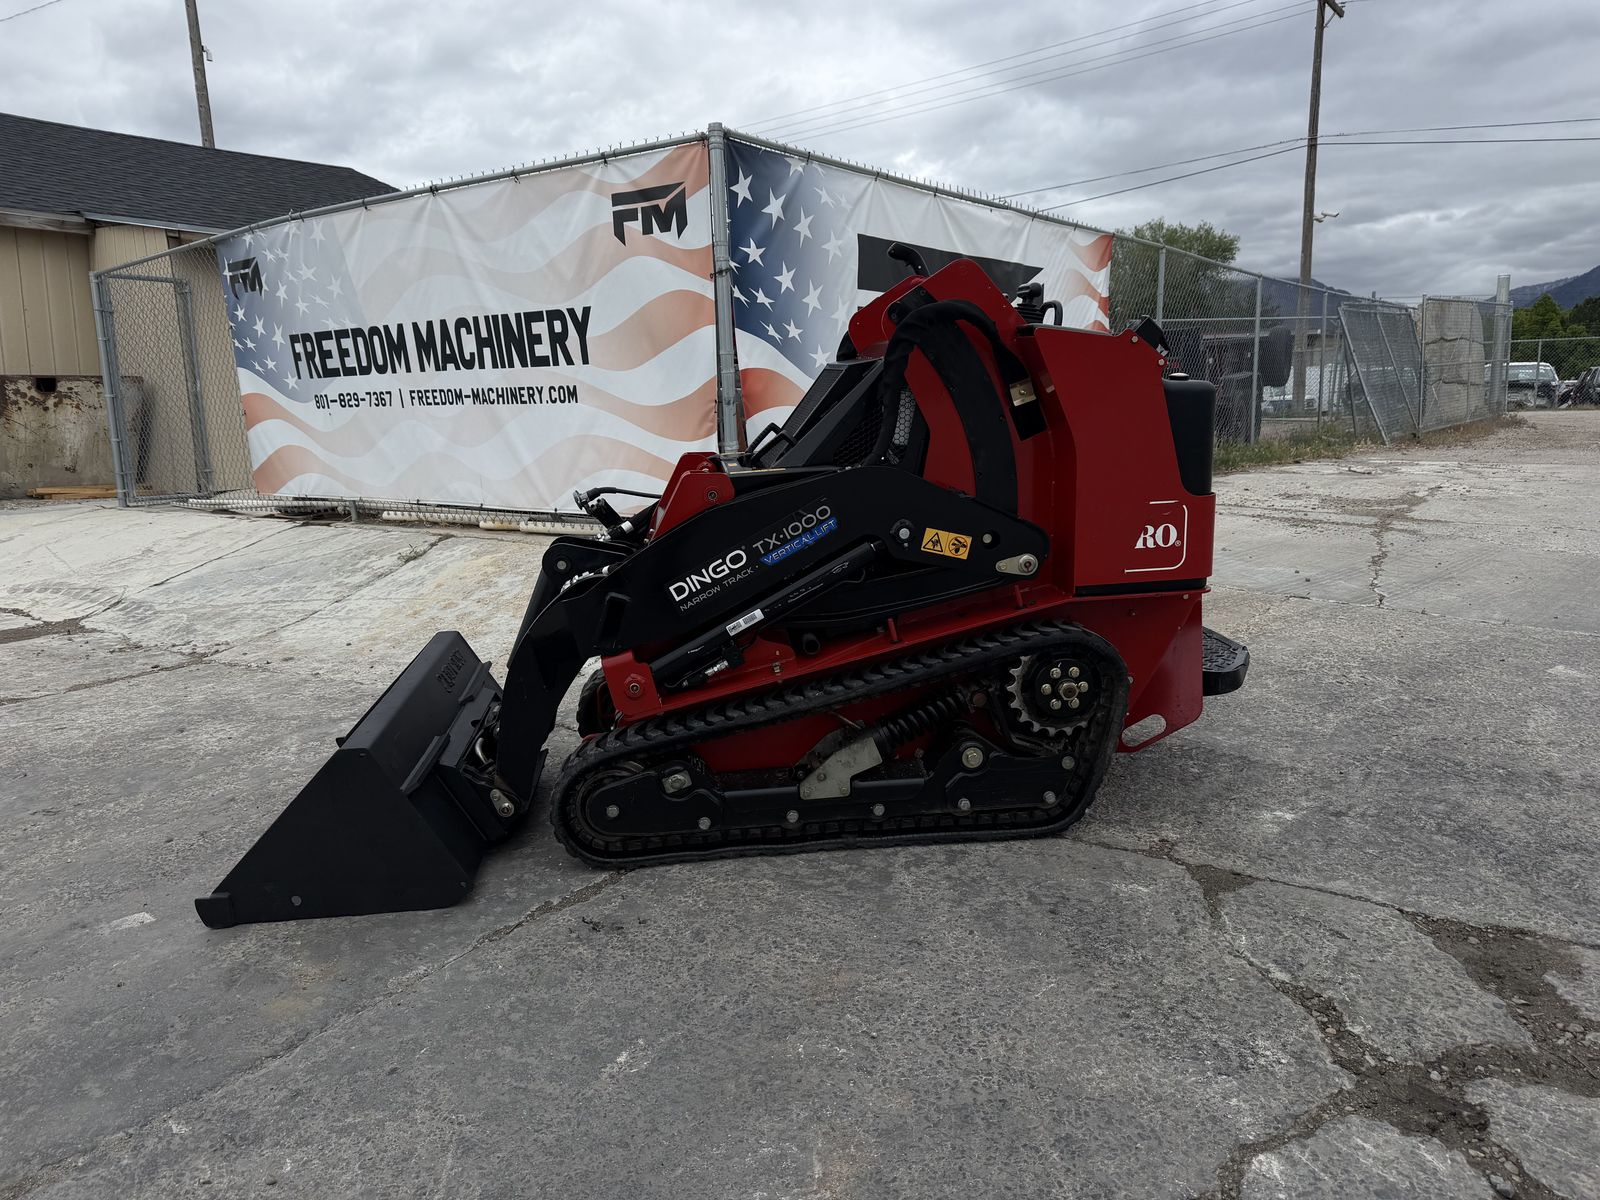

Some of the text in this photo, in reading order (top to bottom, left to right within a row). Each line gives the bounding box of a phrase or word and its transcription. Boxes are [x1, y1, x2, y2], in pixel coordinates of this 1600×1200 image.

[289, 306, 592, 380] FREEDOM MACHINERY
[314, 391, 393, 410] 801-829-7367
[409, 385, 579, 408] FREEDOM-MACHINERY.COM
[764, 519, 837, 563] VERTICAL LIFT
[669, 549, 747, 602] DINGO
[680, 568, 755, 612] NARROW TRACK
